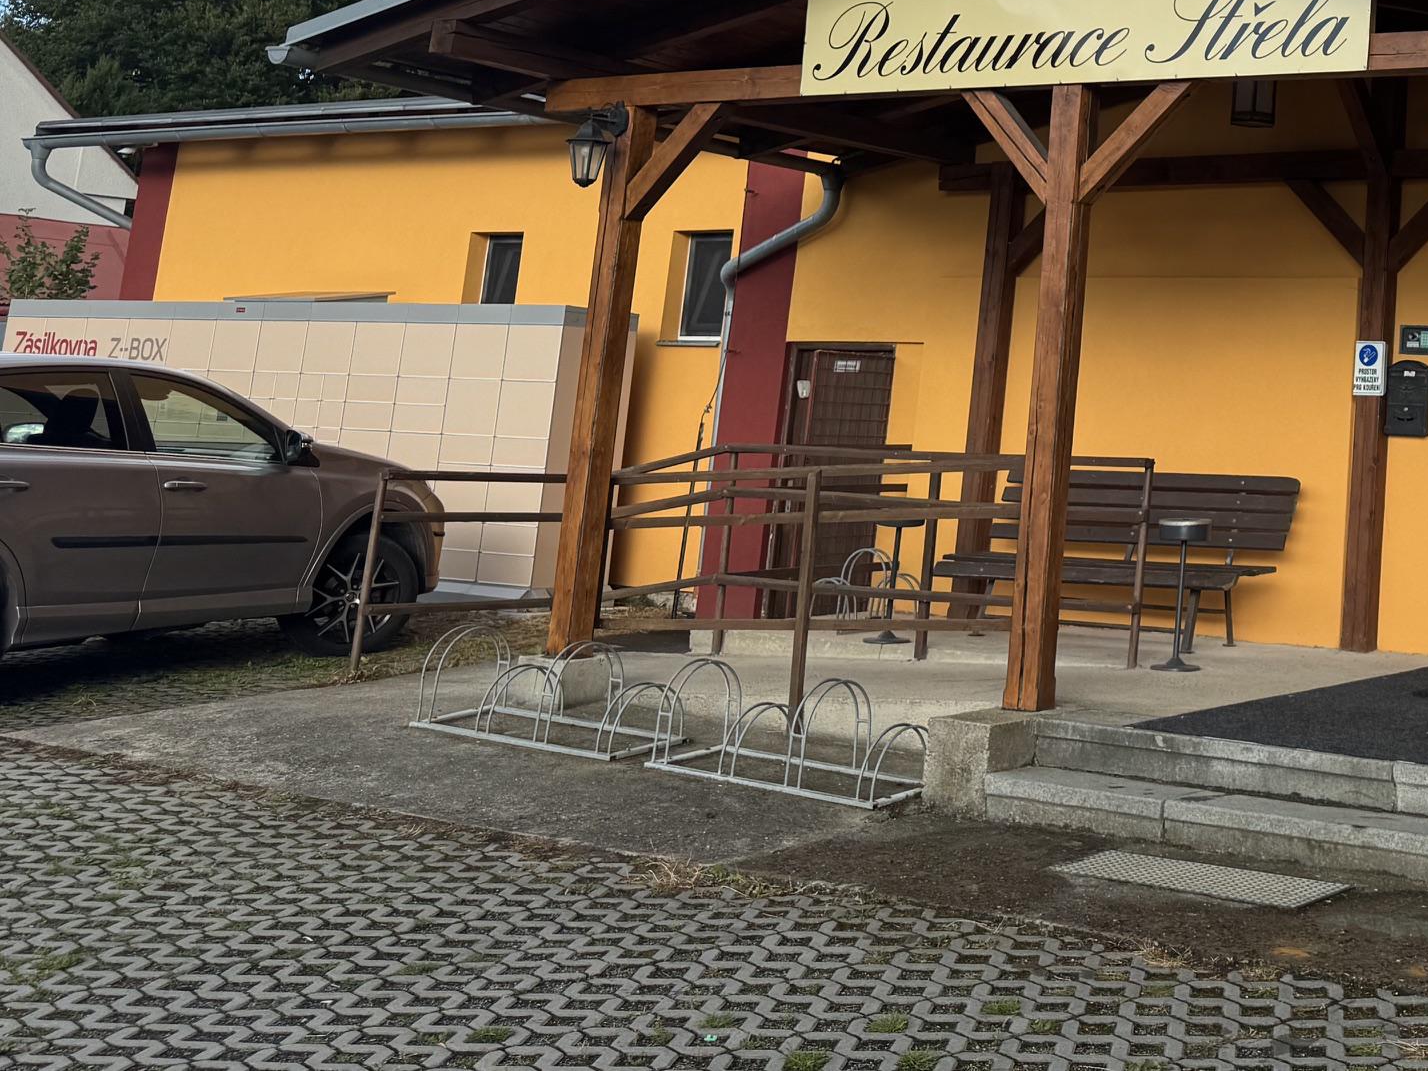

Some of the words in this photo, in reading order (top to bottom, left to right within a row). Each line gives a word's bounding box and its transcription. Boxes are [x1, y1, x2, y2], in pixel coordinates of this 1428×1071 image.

[812, 1, 1130, 81] Restaurace
[14, 331, 97, 356] Zásilkovna
[108, 337, 167, 361] Z-BOX
